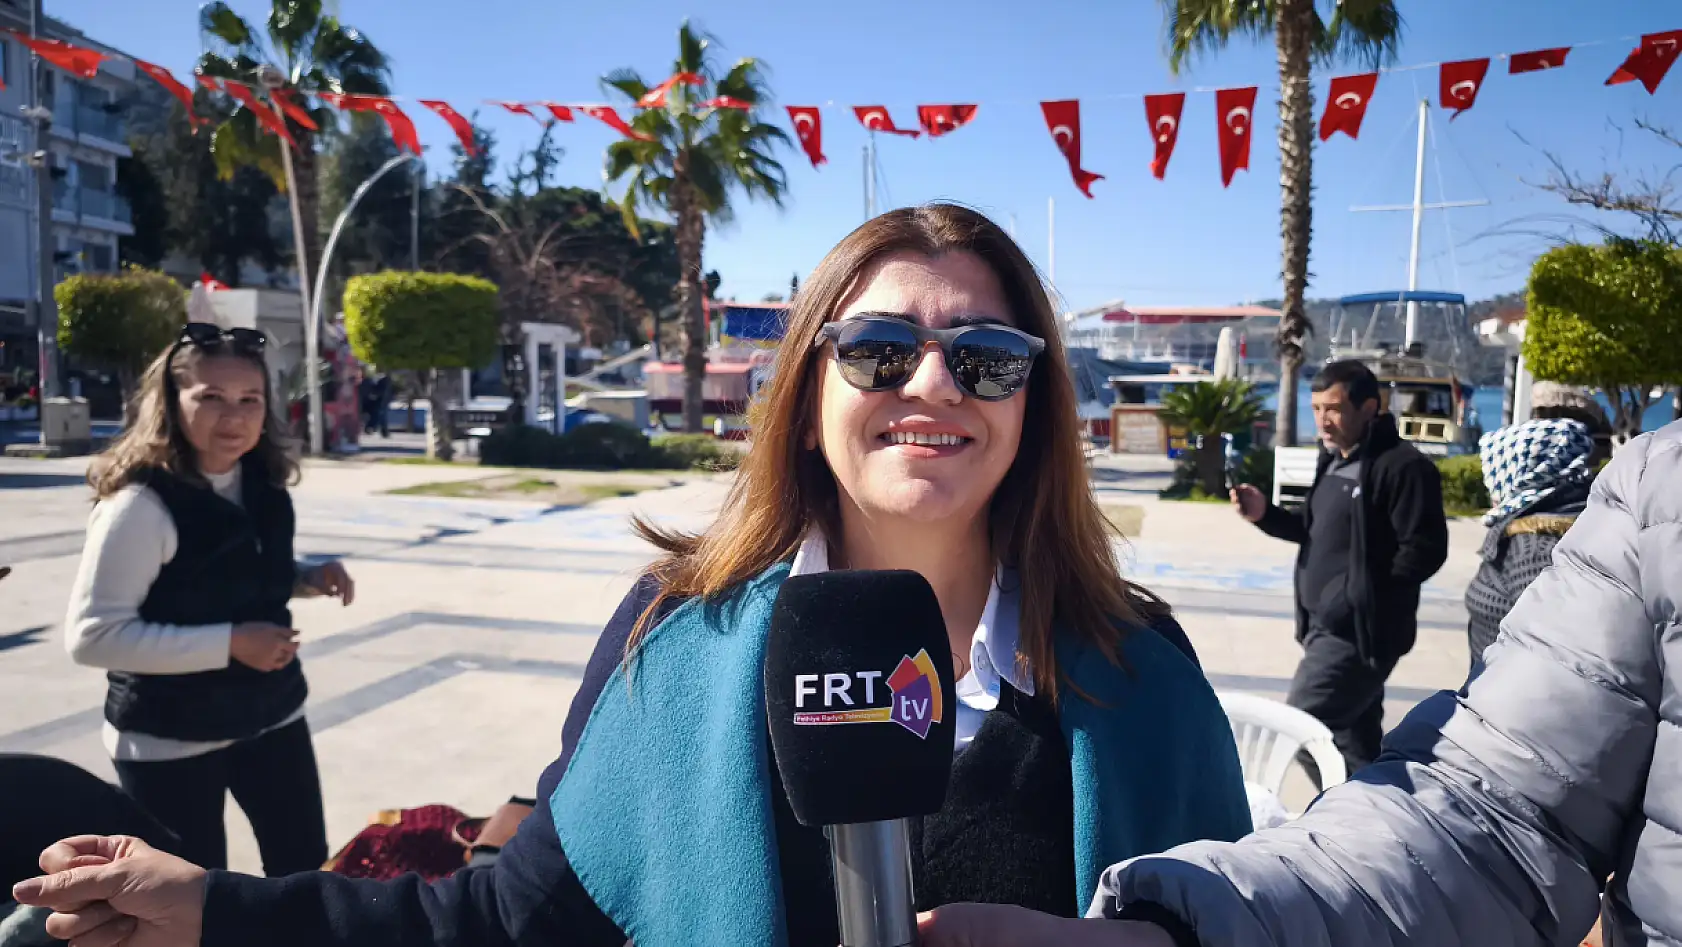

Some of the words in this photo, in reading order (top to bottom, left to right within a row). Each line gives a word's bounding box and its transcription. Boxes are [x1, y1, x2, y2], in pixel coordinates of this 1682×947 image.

[795, 671, 882, 708] FRT
[822, 714, 844, 722] Radyo
[900, 695, 929, 721] tv
